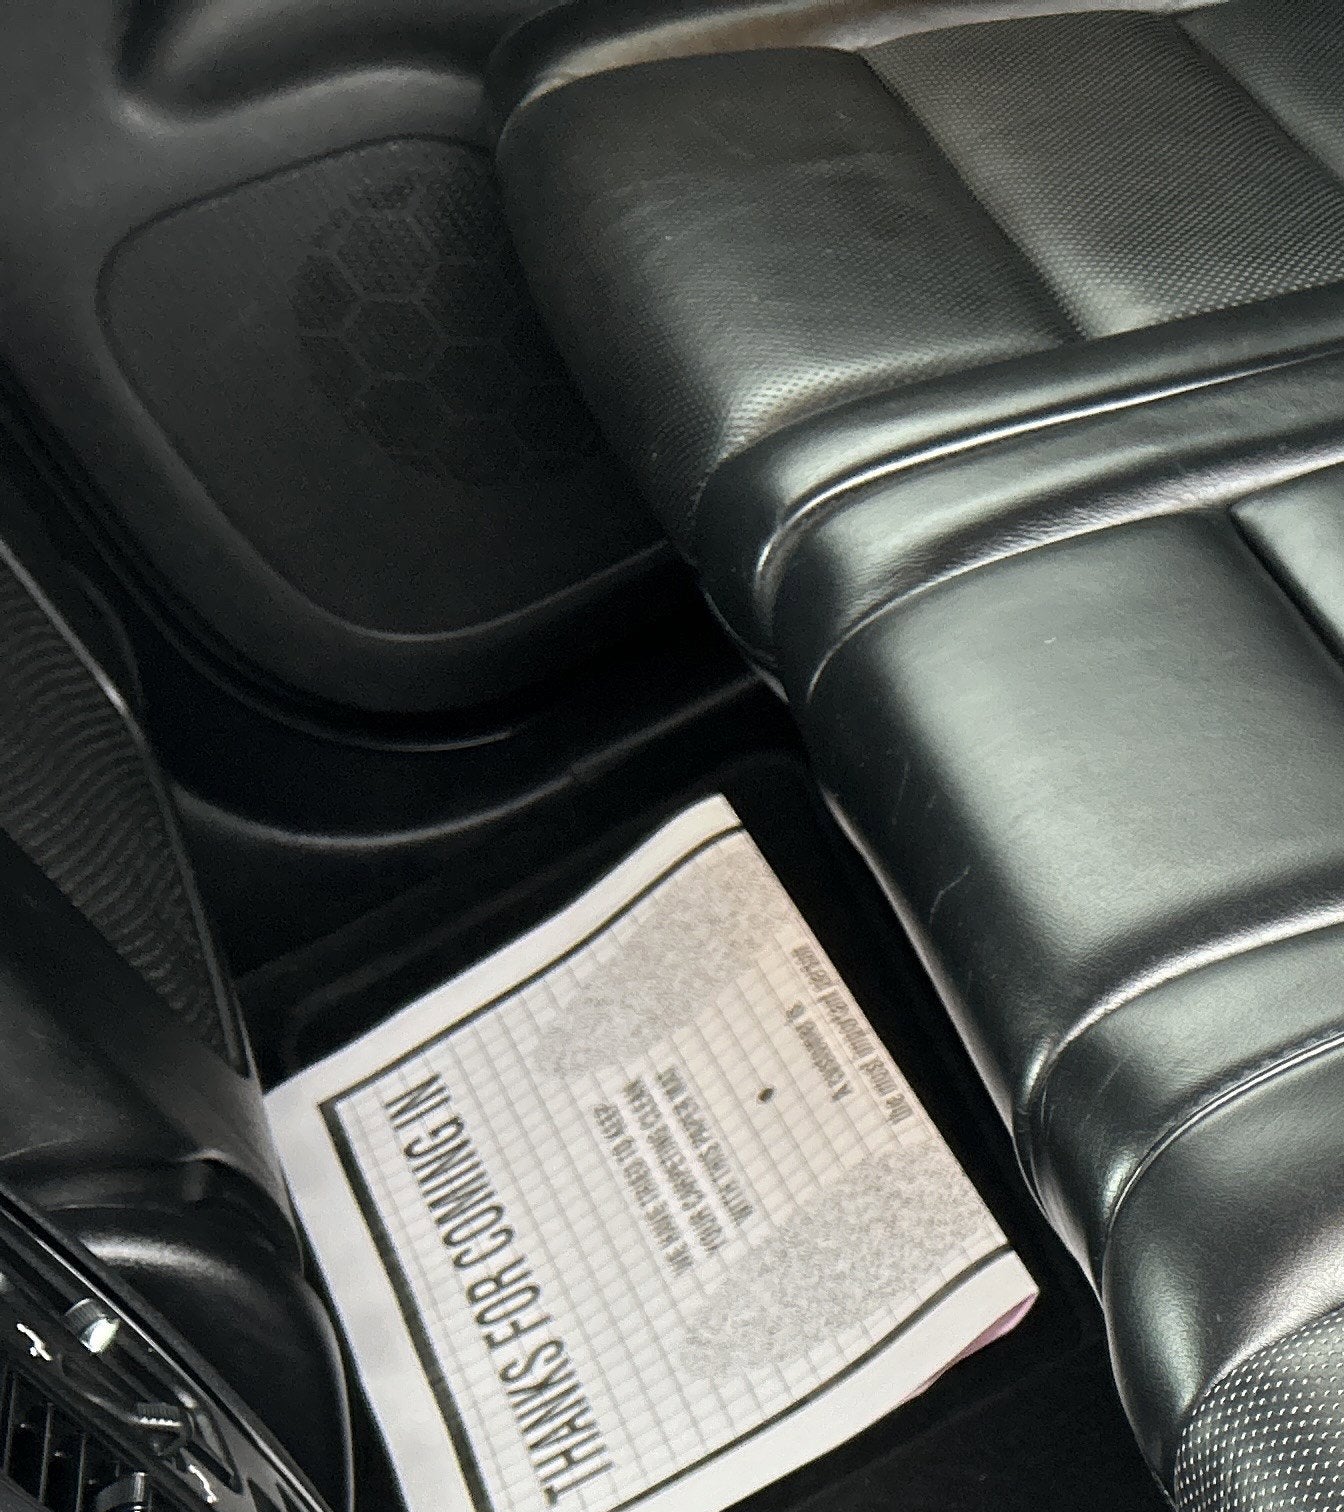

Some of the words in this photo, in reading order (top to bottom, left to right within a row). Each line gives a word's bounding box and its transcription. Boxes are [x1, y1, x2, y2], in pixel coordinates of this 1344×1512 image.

[383, 1072, 451, 1131] IN
[402, 1116, 516, 1271] COMING
[466, 1257, 553, 1353] FOR
[498, 1338, 615, 1506] THANKS
